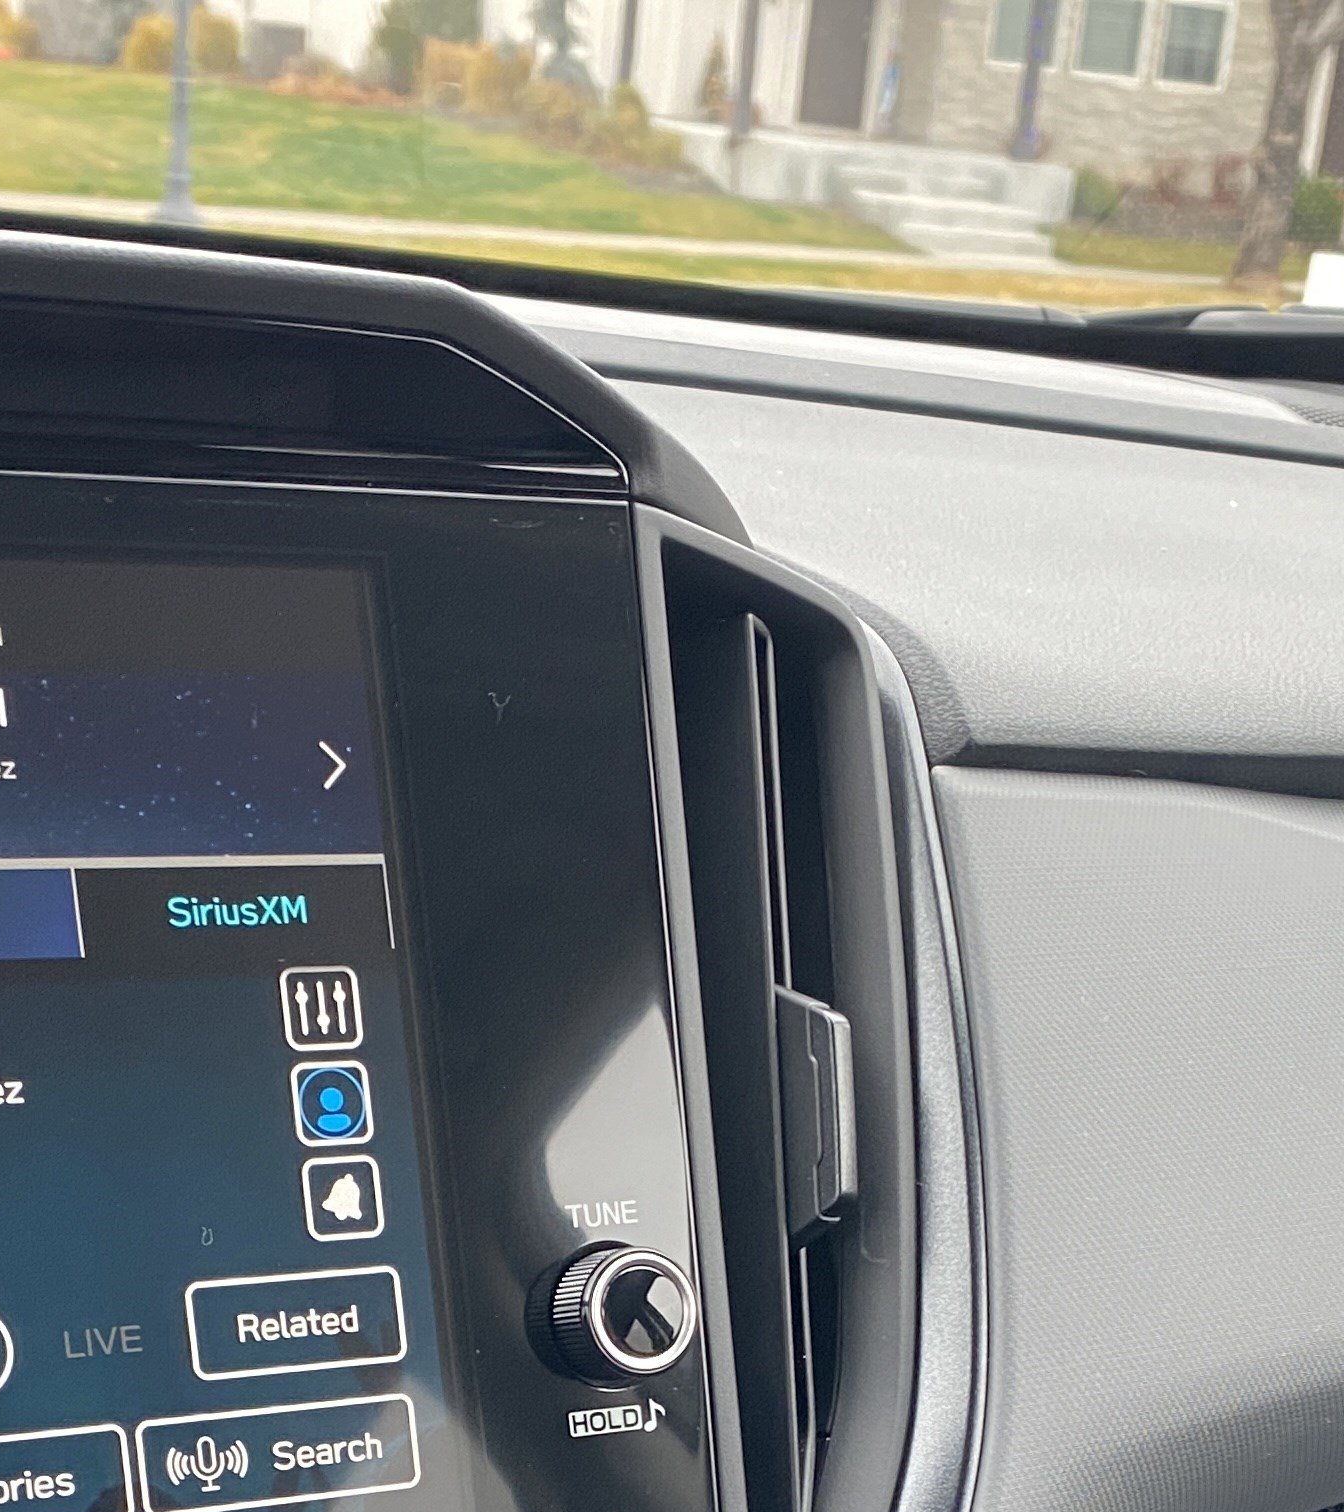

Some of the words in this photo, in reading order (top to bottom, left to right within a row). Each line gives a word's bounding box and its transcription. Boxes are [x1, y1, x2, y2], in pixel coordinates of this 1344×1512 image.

[166, 895, 308, 928] SiriusXM
[565, 1200, 639, 1228] TUNE
[237, 1304, 359, 1344] Related
[63, 1325, 144, 1359] LIVE
[571, 1407, 640, 1436] HOLD
[272, 1432, 384, 1472] Search
